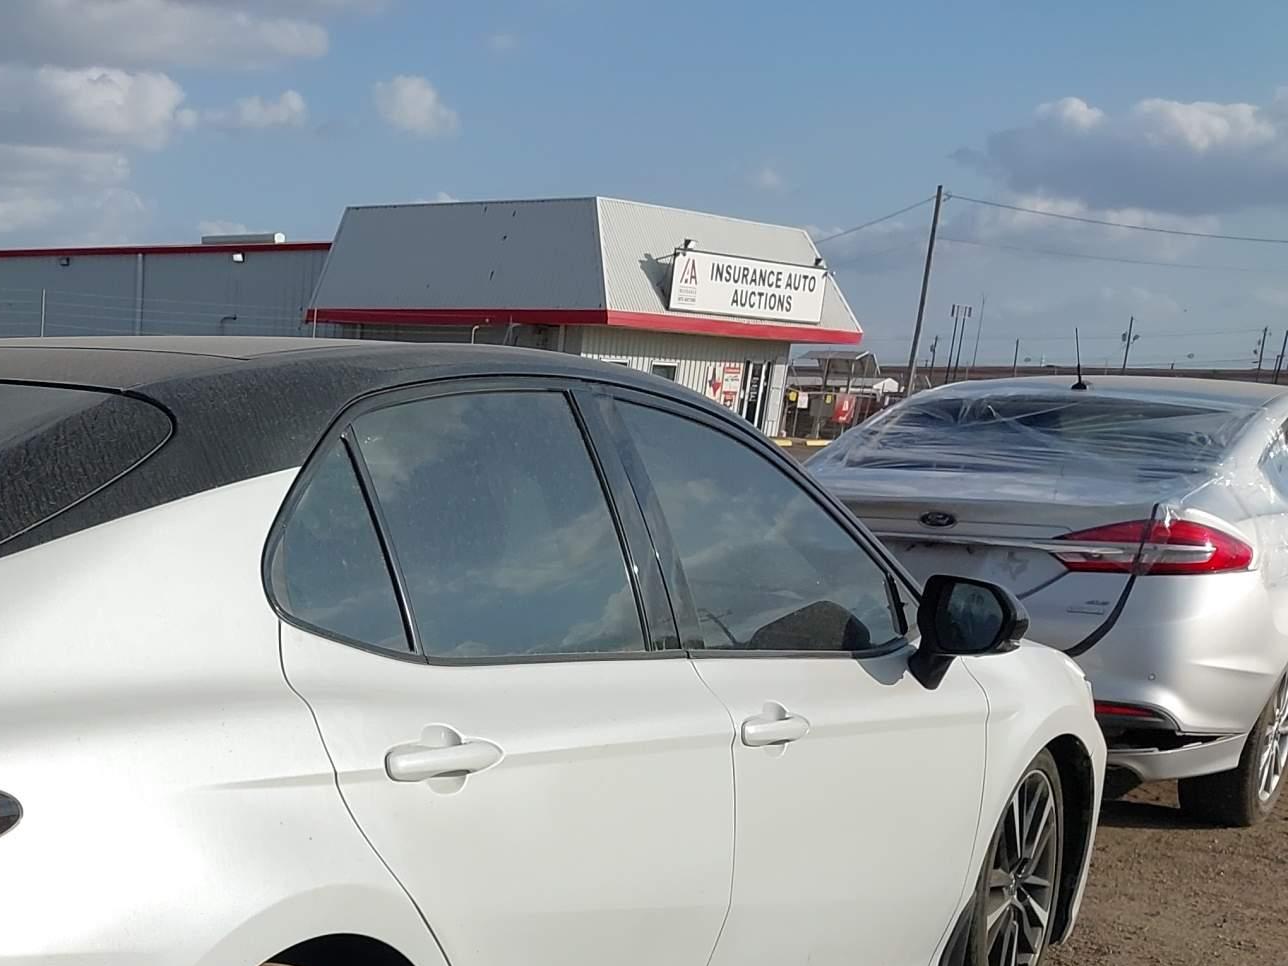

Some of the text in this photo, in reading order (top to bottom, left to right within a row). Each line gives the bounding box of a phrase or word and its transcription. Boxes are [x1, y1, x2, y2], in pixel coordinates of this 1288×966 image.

[710, 263, 817, 293] INSURANCE AUTO
[730, 289, 792, 312] AUCTIONS
